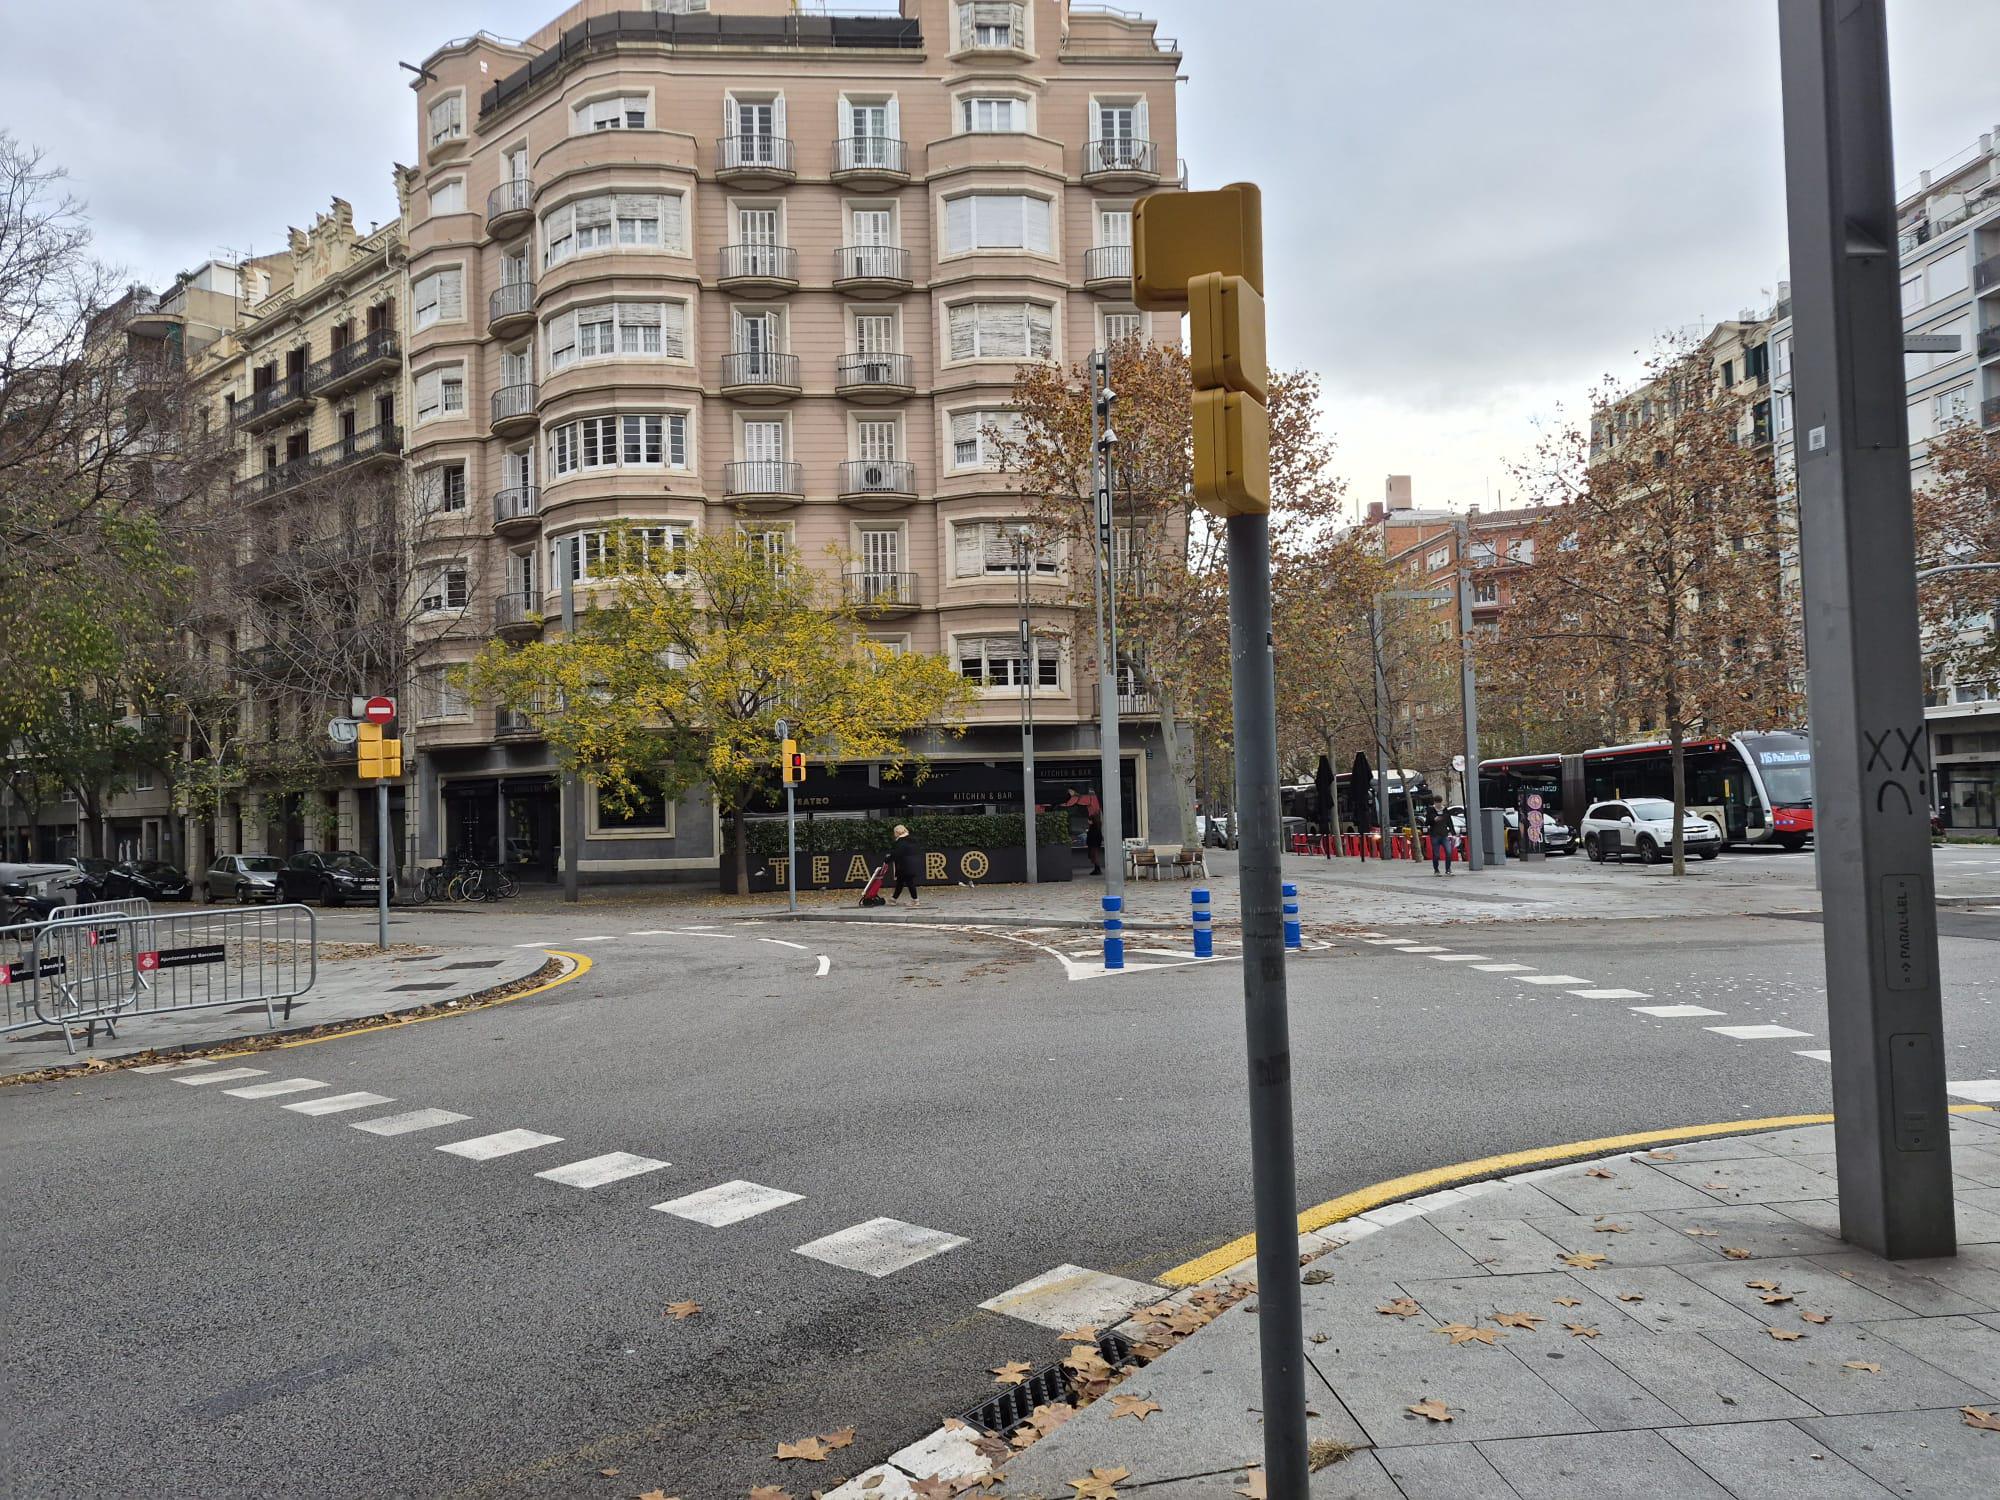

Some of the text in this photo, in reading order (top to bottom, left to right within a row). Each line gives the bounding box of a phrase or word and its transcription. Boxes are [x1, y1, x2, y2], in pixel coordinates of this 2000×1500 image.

[953, 792, 986, 801] KITCHEN
[997, 791, 1013, 800] BAR
[768, 850, 989, 885] TEARO
[160, 954, 190, 963] Ajuntament
